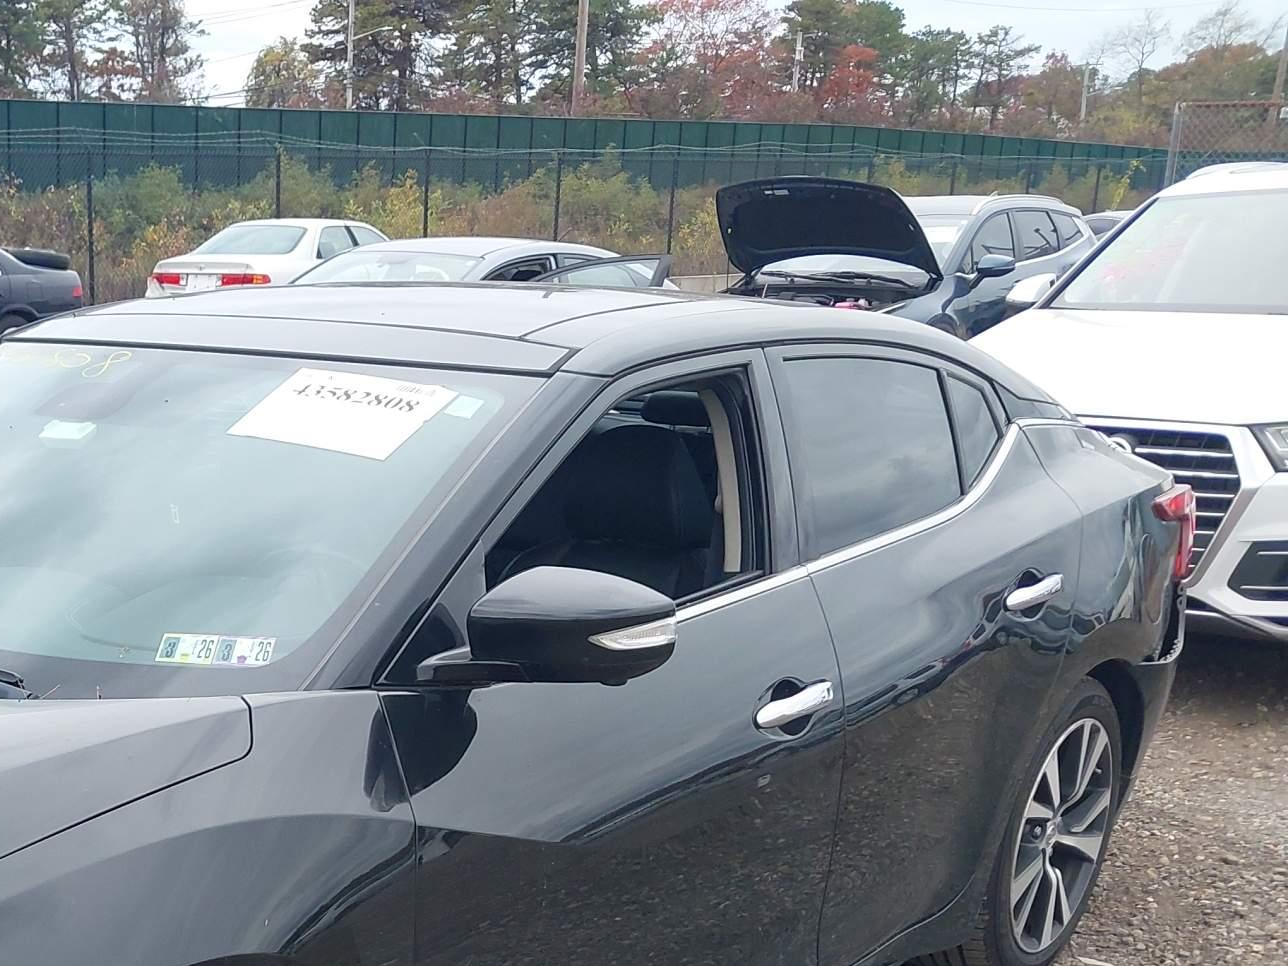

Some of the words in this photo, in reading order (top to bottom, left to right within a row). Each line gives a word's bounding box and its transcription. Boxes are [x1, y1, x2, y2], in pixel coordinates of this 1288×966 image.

[292, 383, 420, 413] 43582808
[197, 639, 214, 659] 26
[222, 643, 232, 661] 3
[255, 641, 272, 662] 26
